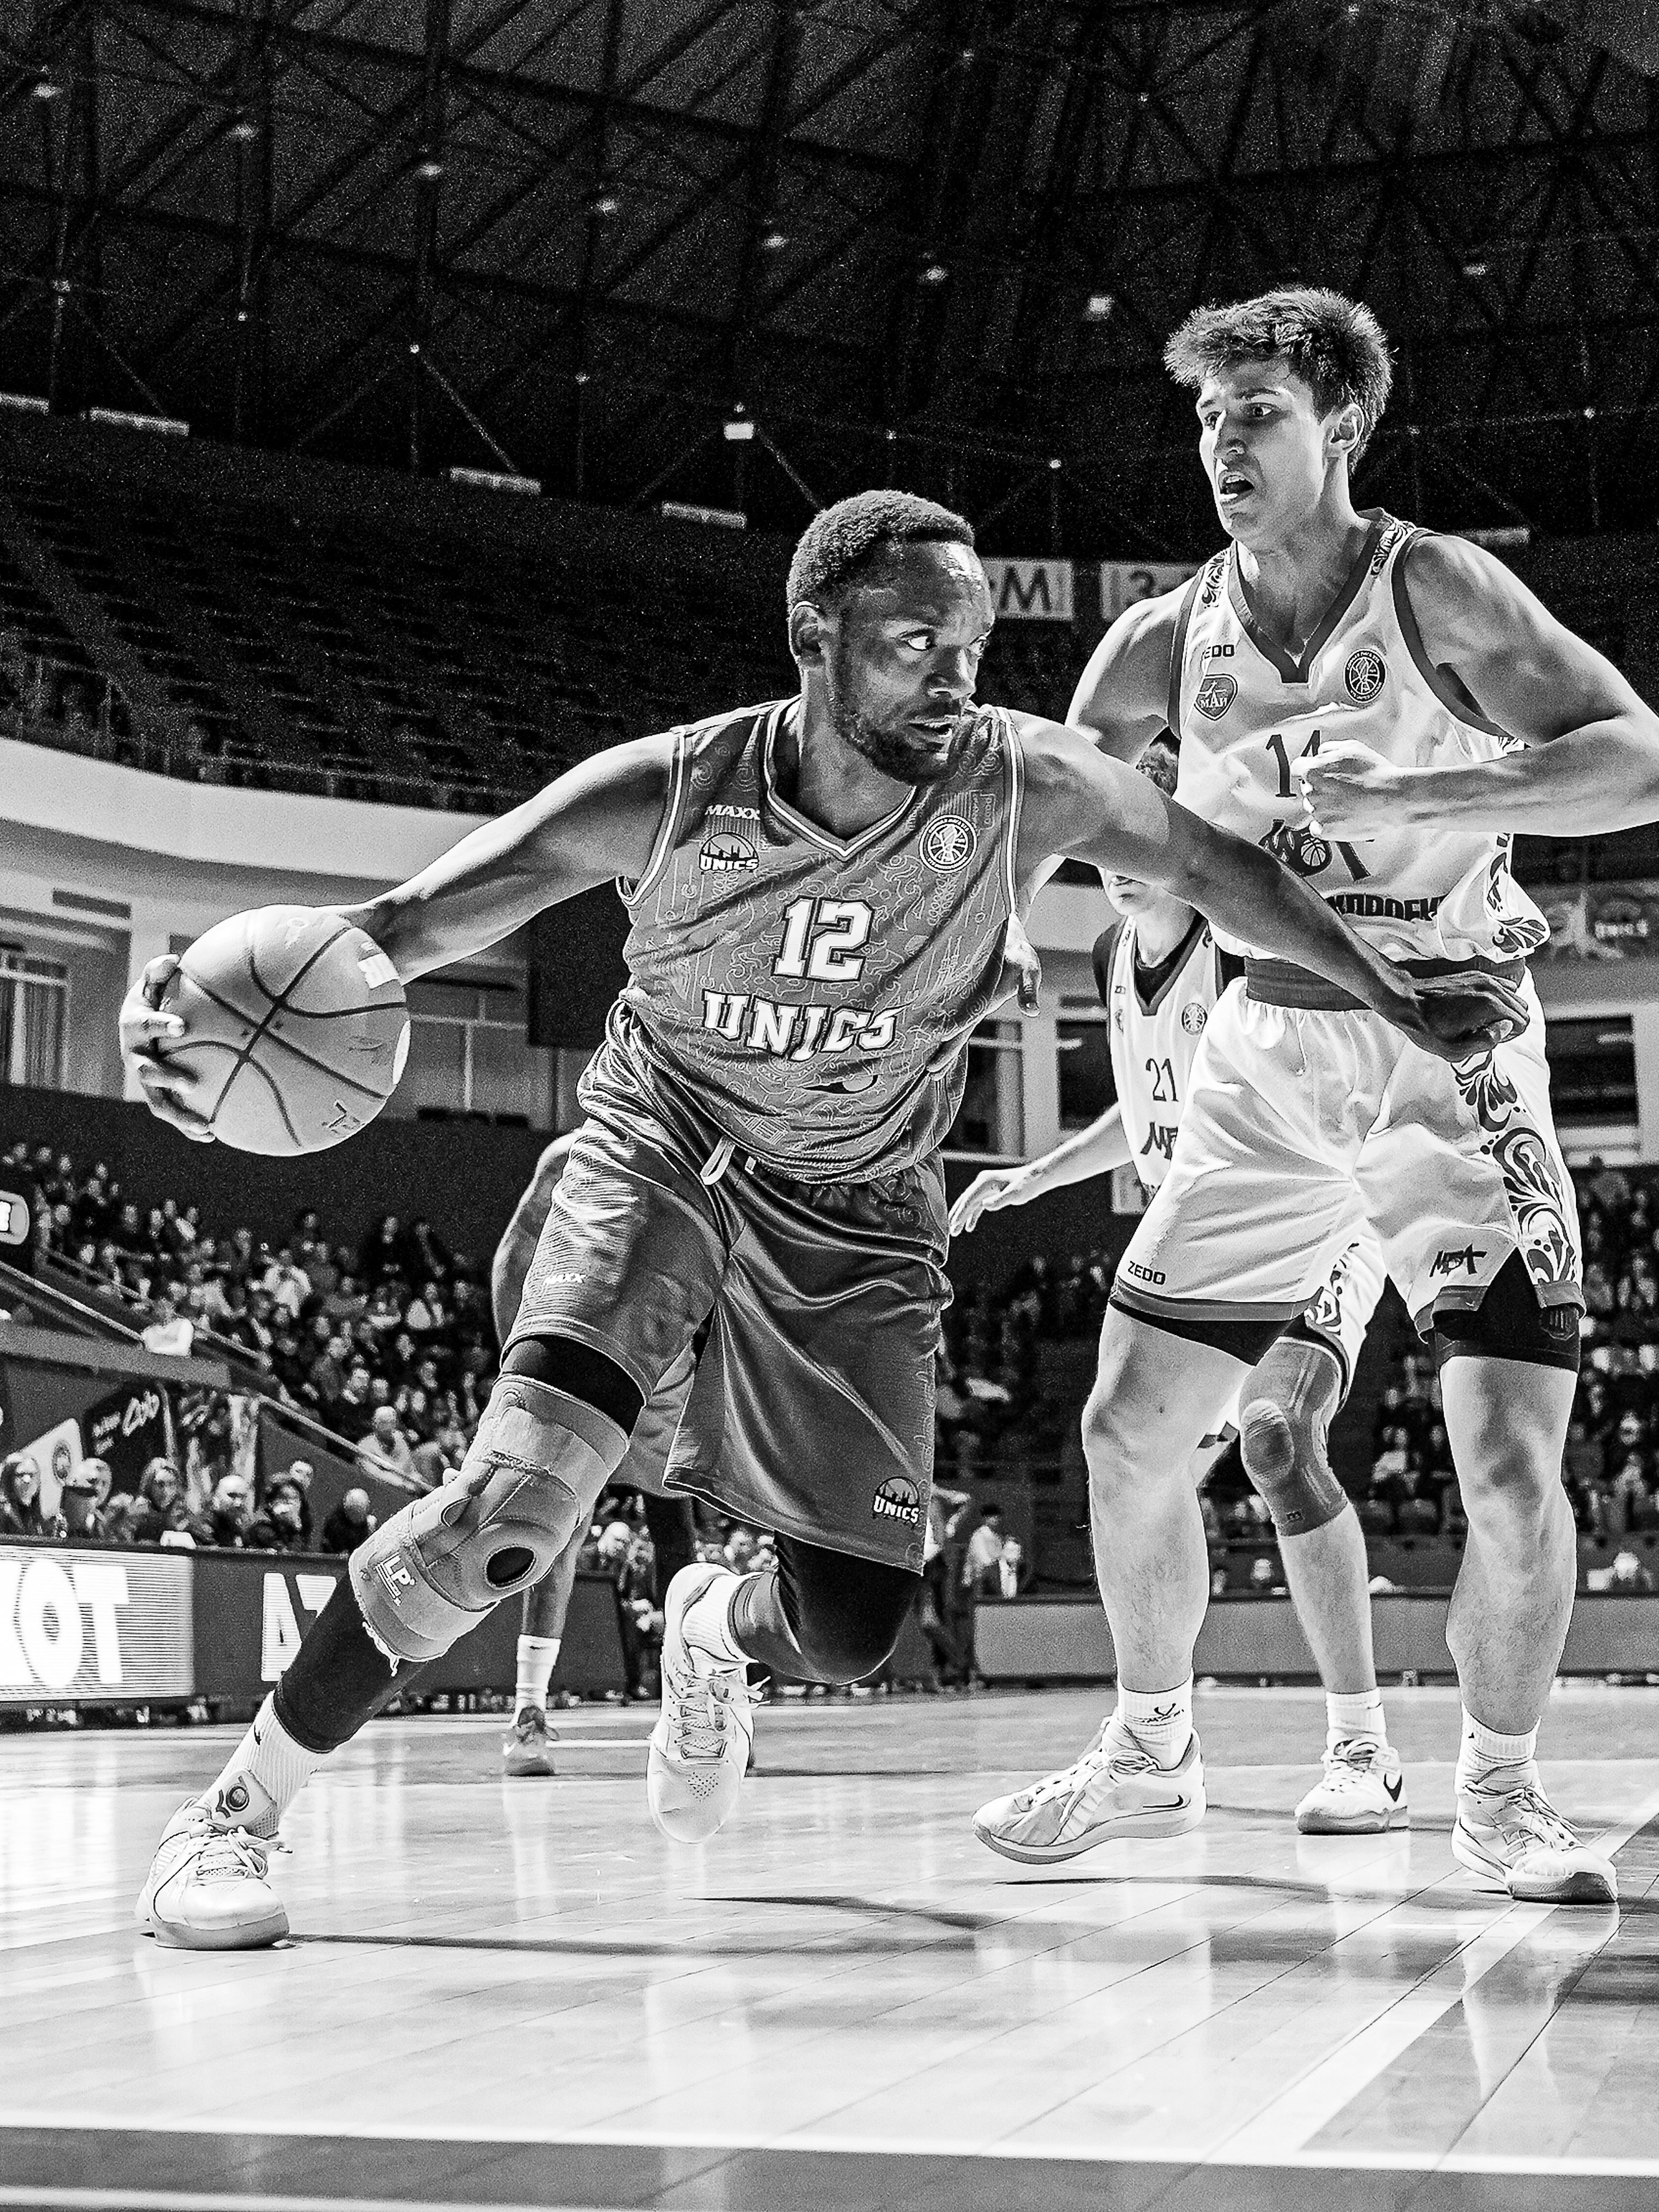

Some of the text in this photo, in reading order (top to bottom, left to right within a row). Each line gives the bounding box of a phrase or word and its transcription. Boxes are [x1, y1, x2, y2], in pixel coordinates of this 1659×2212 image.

[704, 804, 761, 821] MAXX
[699, 854, 760, 871] UNICS
[773, 895, 875, 981] 12
[702, 989, 912, 1062] UNICS
[1146, 1058, 1179, 1102] 21
[1128, 1260, 1166, 1285] ZEDO
[873, 1495, 920, 1524] UNICS
